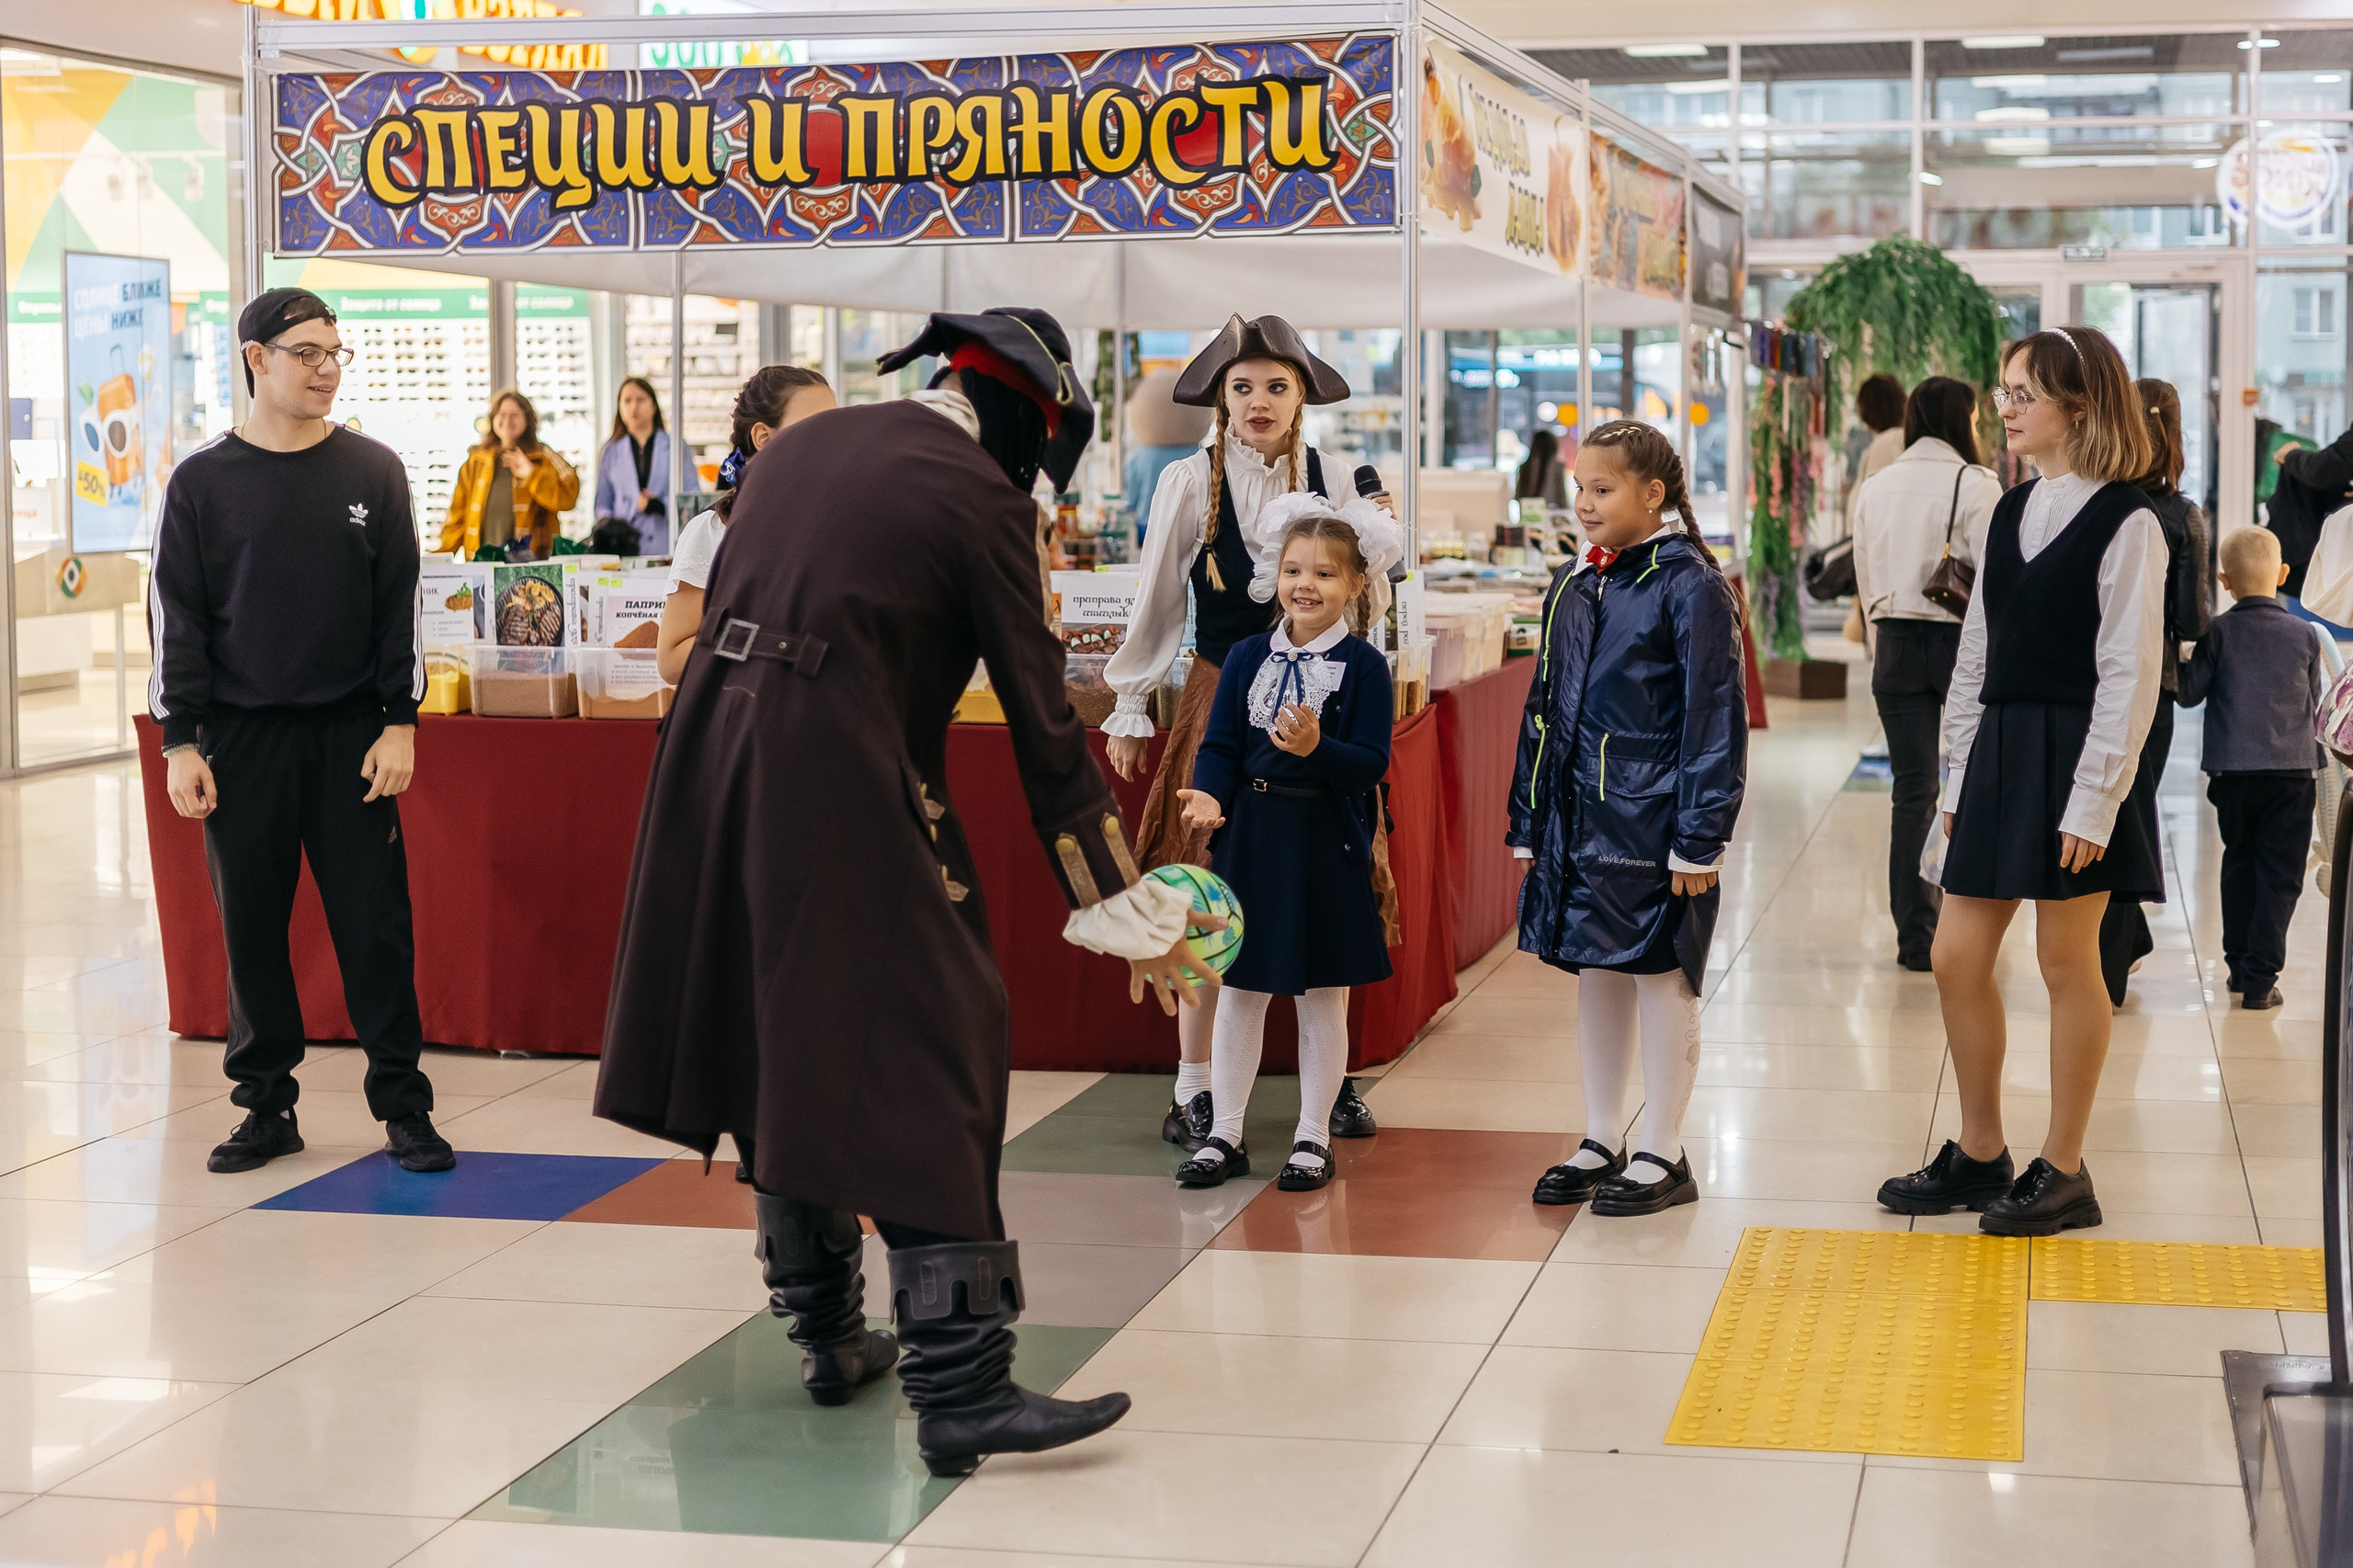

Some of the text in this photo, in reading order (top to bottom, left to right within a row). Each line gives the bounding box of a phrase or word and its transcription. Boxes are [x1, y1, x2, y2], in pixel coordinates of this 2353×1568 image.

[361, 96, 724, 216] СПЕЦИИ
[736, 94, 818, 186] И
[826, 73, 1340, 191] ПРЯНОСТИ
[1073, 597, 1120, 608] приправа
[1083, 608, 1131, 619] шашлык
